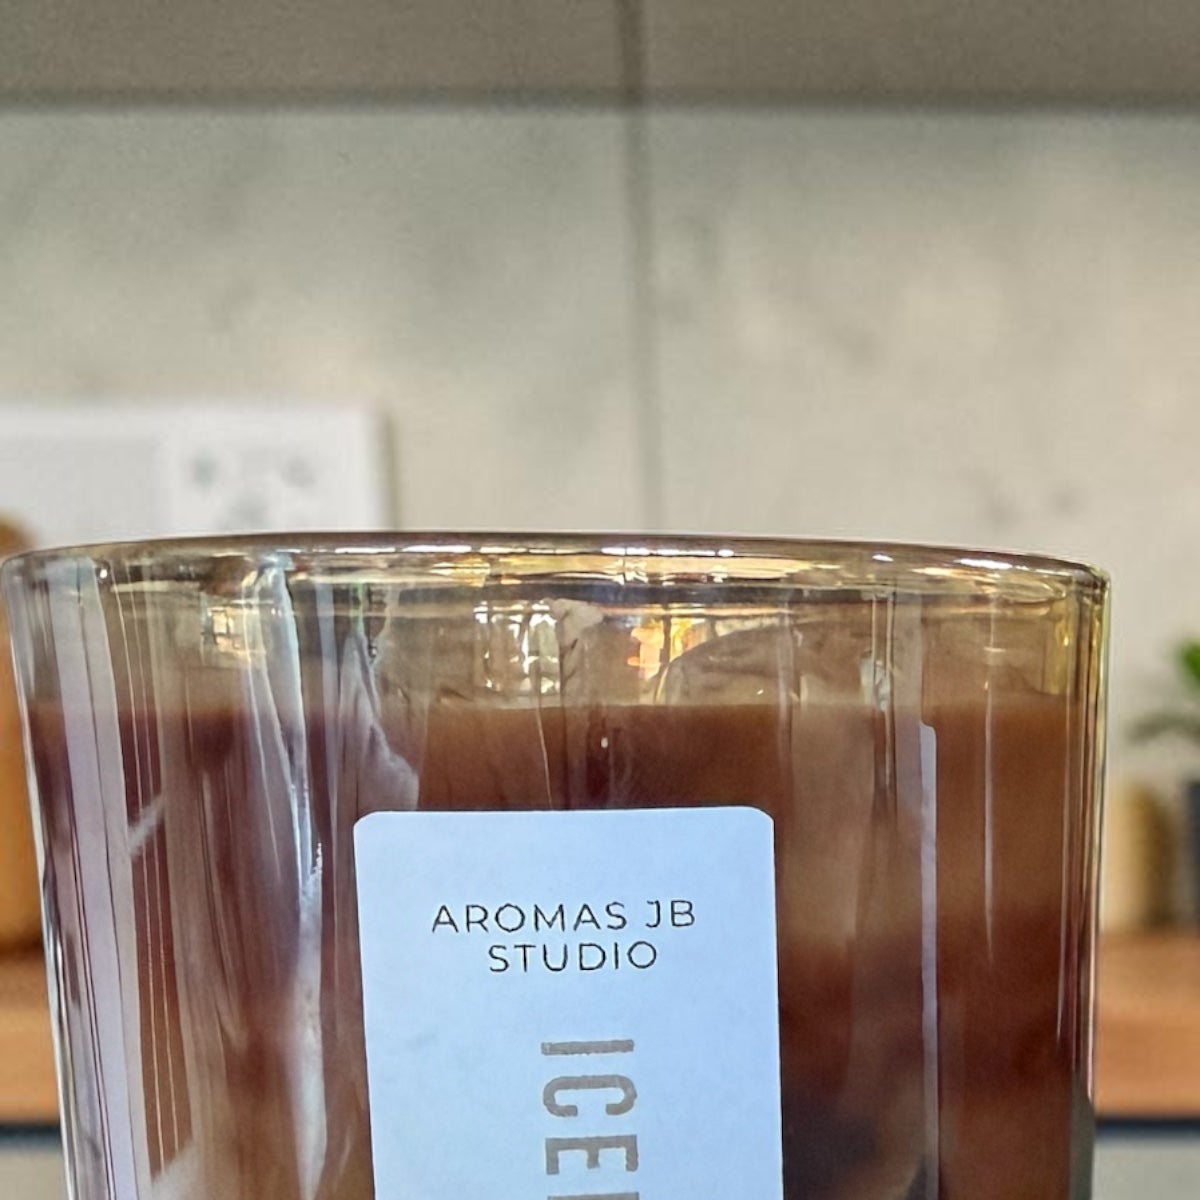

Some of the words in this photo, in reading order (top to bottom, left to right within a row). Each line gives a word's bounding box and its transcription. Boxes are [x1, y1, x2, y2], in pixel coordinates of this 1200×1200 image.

[431, 902, 627, 933] AROMAS
[645, 900, 696, 929] JB
[488, 941, 657, 973] STUDIO
